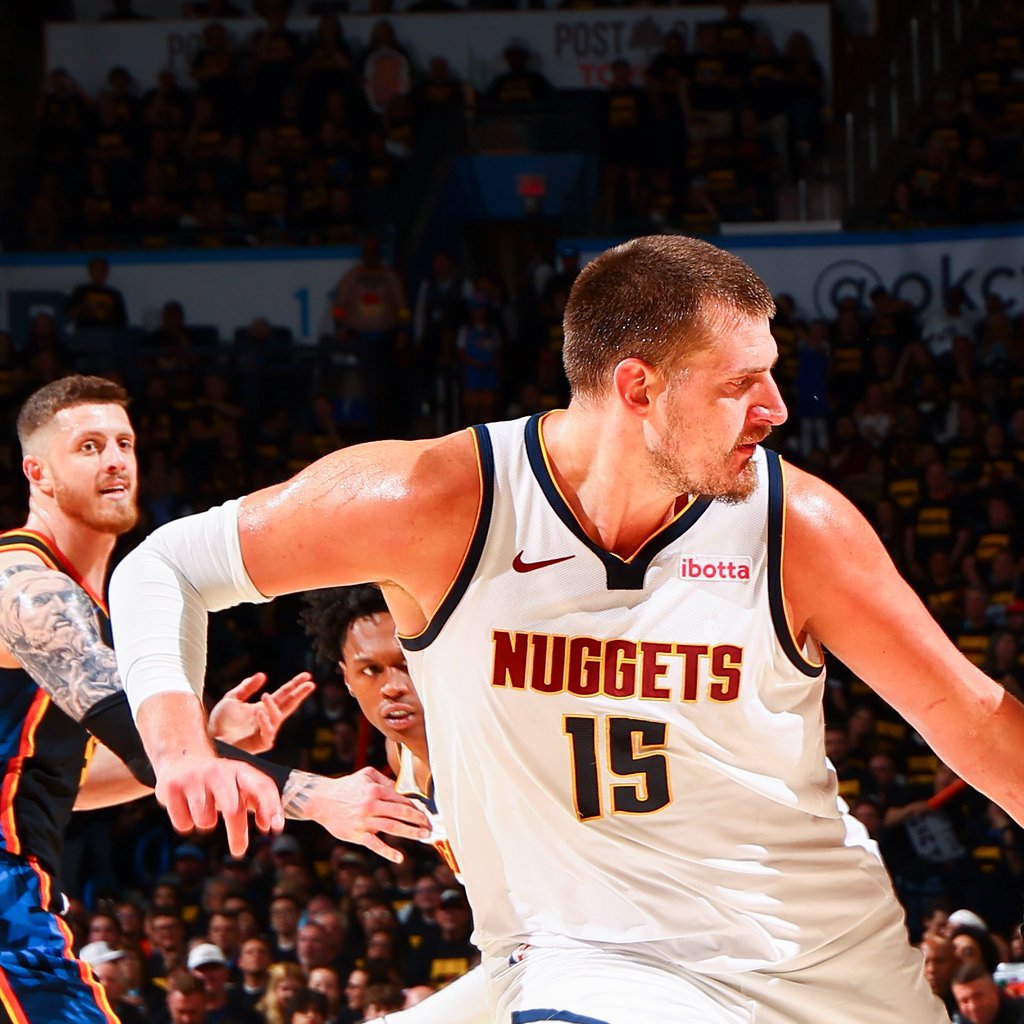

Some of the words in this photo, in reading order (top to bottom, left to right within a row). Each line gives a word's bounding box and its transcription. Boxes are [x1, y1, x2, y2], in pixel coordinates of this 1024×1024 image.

[554, 21, 625, 56] POST
[681, 558, 750, 579] ibotta
[491, 629, 743, 703] NUGGETS
[562, 713, 673, 822] 15
